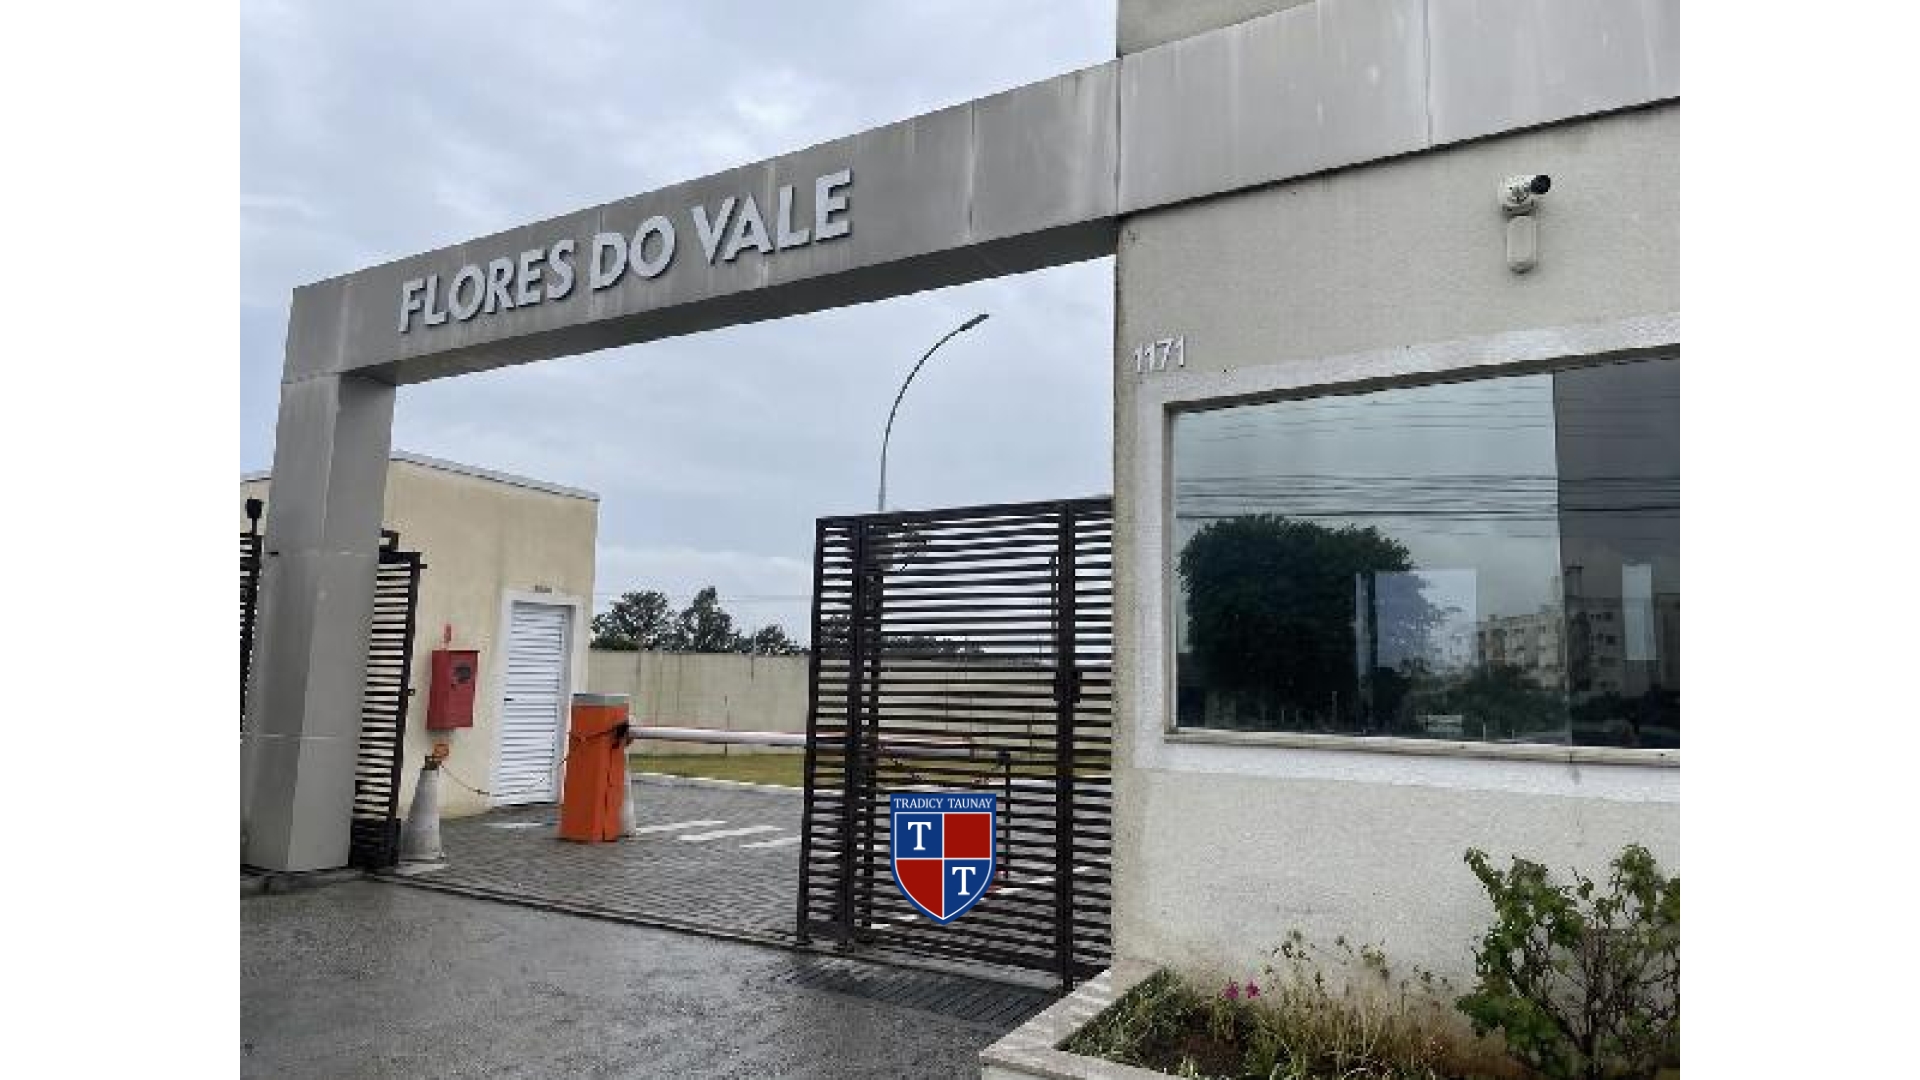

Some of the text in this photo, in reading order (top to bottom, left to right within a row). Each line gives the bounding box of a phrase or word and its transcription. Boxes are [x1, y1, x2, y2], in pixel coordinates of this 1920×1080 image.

[399, 167, 854, 333] FLORES DO VALE
[1134, 334, 1185, 374] 1171
